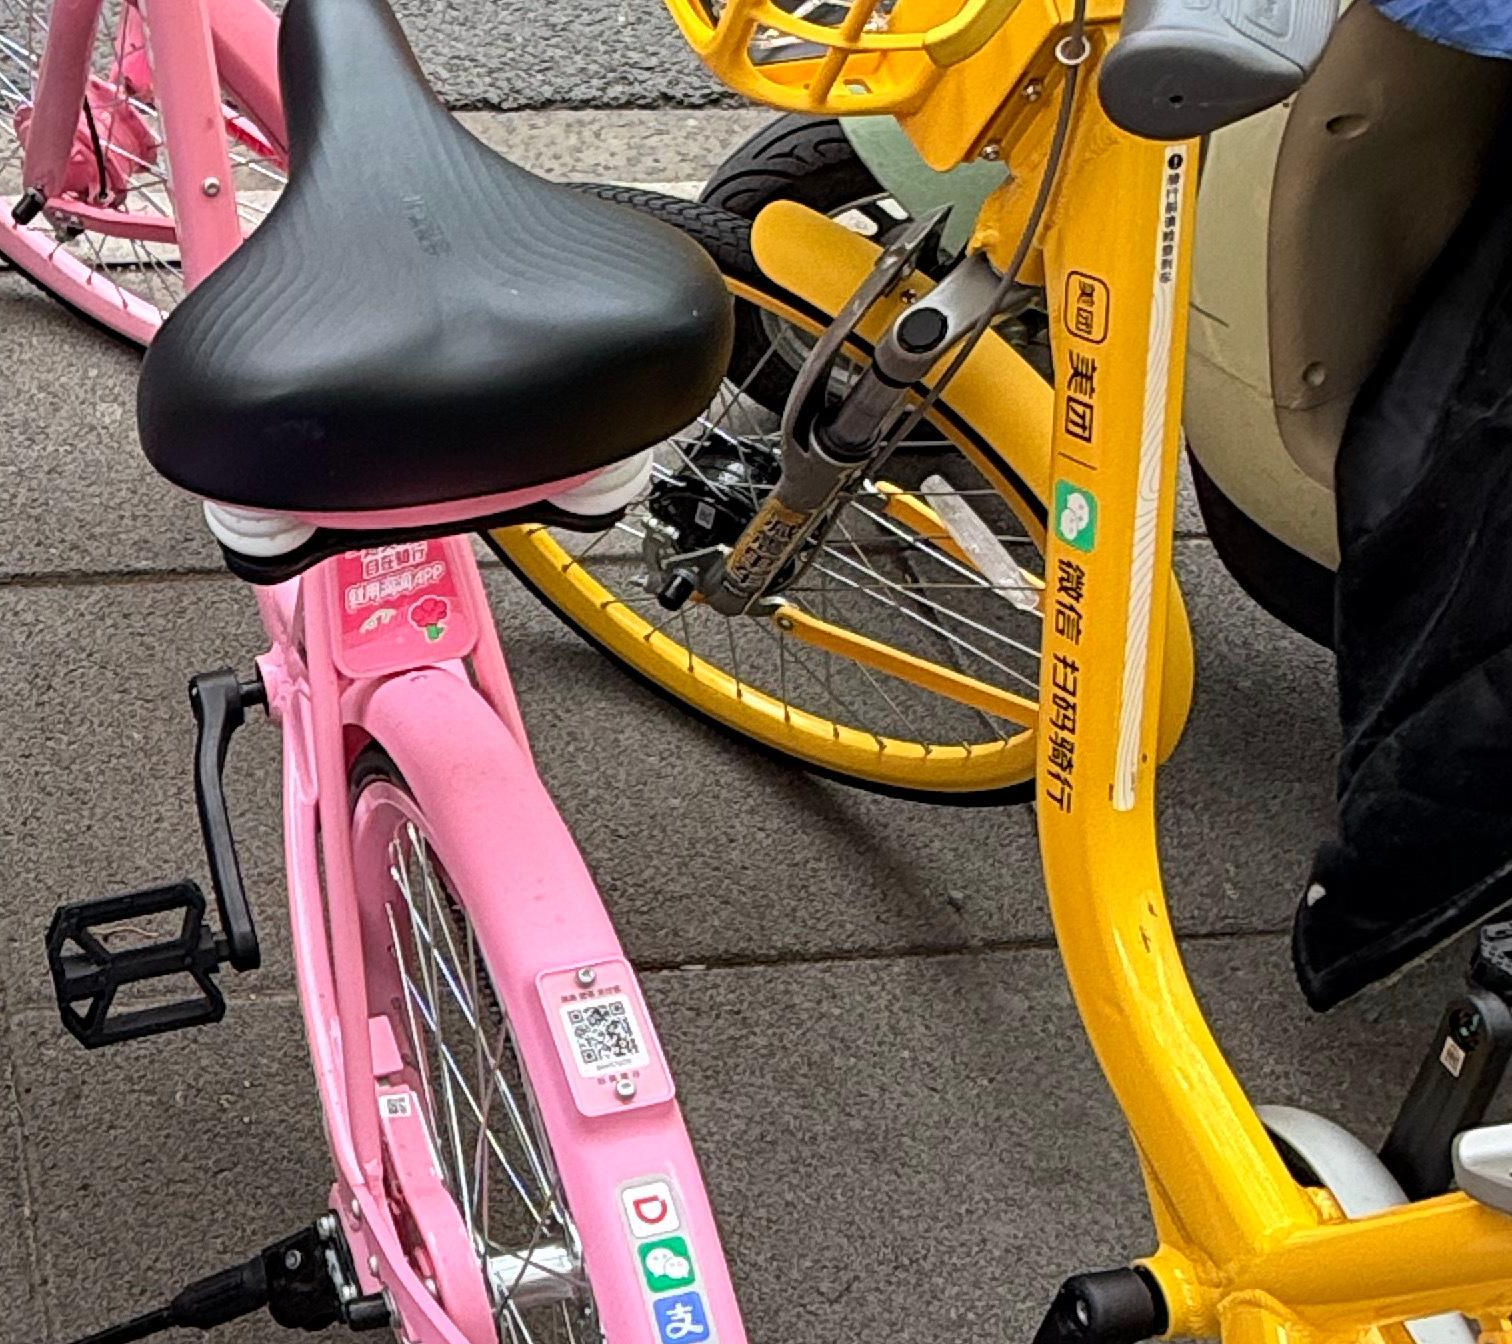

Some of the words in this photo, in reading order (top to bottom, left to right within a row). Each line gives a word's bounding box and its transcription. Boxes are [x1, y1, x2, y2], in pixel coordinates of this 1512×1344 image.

[1065, 349, 1098, 444] 美团
[1055, 558, 1086, 646] 微信
[1046, 652, 1080, 814] 扫码骑行
